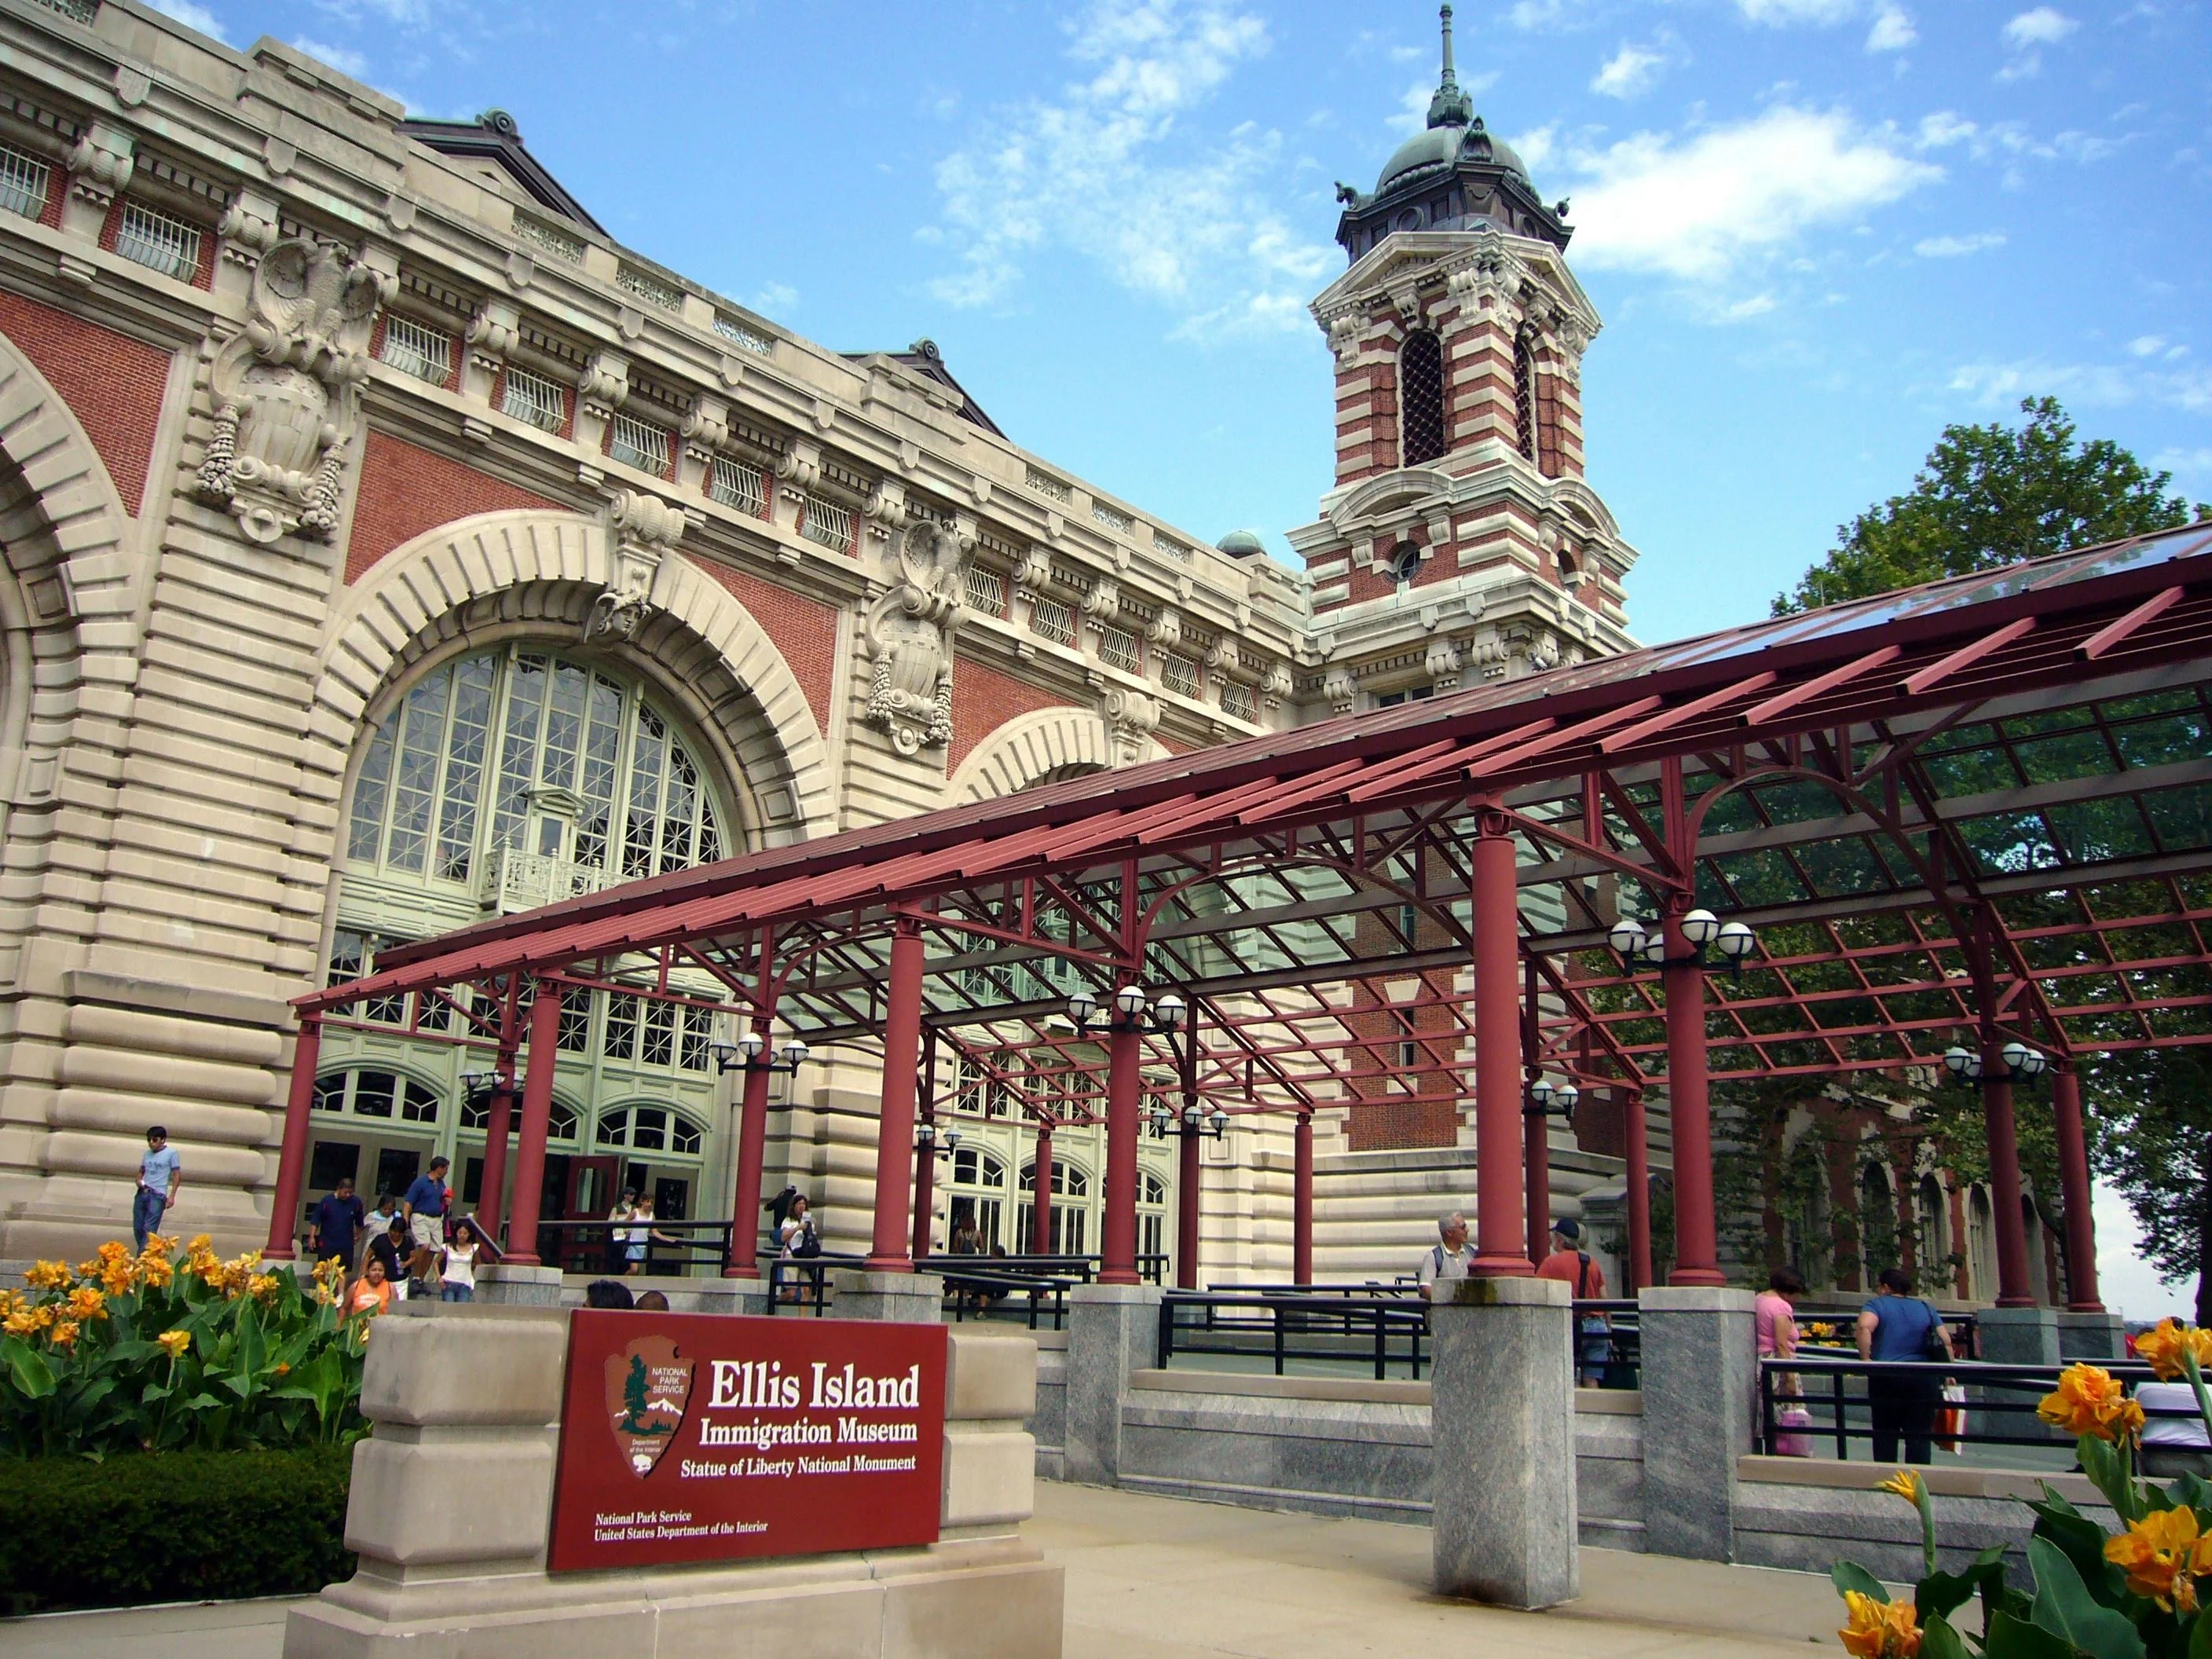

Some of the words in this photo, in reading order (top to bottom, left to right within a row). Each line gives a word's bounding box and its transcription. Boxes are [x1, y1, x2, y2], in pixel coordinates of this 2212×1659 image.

[652, 1367, 688, 1376] NATIONAL
[653, 1385, 685, 1393] SERVICE
[708, 1360, 800, 1408] Ellis
[809, 1362, 920, 1408] Island
[699, 1416, 832, 1451] Immigration
[837, 1416, 917, 1443] Museum
[680, 1458, 727, 1478] Statue
[730, 1458, 745, 1475] of
[747, 1457, 794, 1478] Liberty
[797, 1455, 850, 1474] National
[854, 1454, 917, 1471] Monument
[595, 1513, 634, 1525] National
[636, 1511, 657, 1523] Park
[659, 1510, 692, 1522] Service
[594, 1529, 625, 1541] United
[627, 1527, 655, 1539] States
[657, 1524, 709, 1540] Department
[711, 1522, 720, 1534] of
[720, 1522, 734, 1533] the
[737, 1520, 768, 1531] Interior
